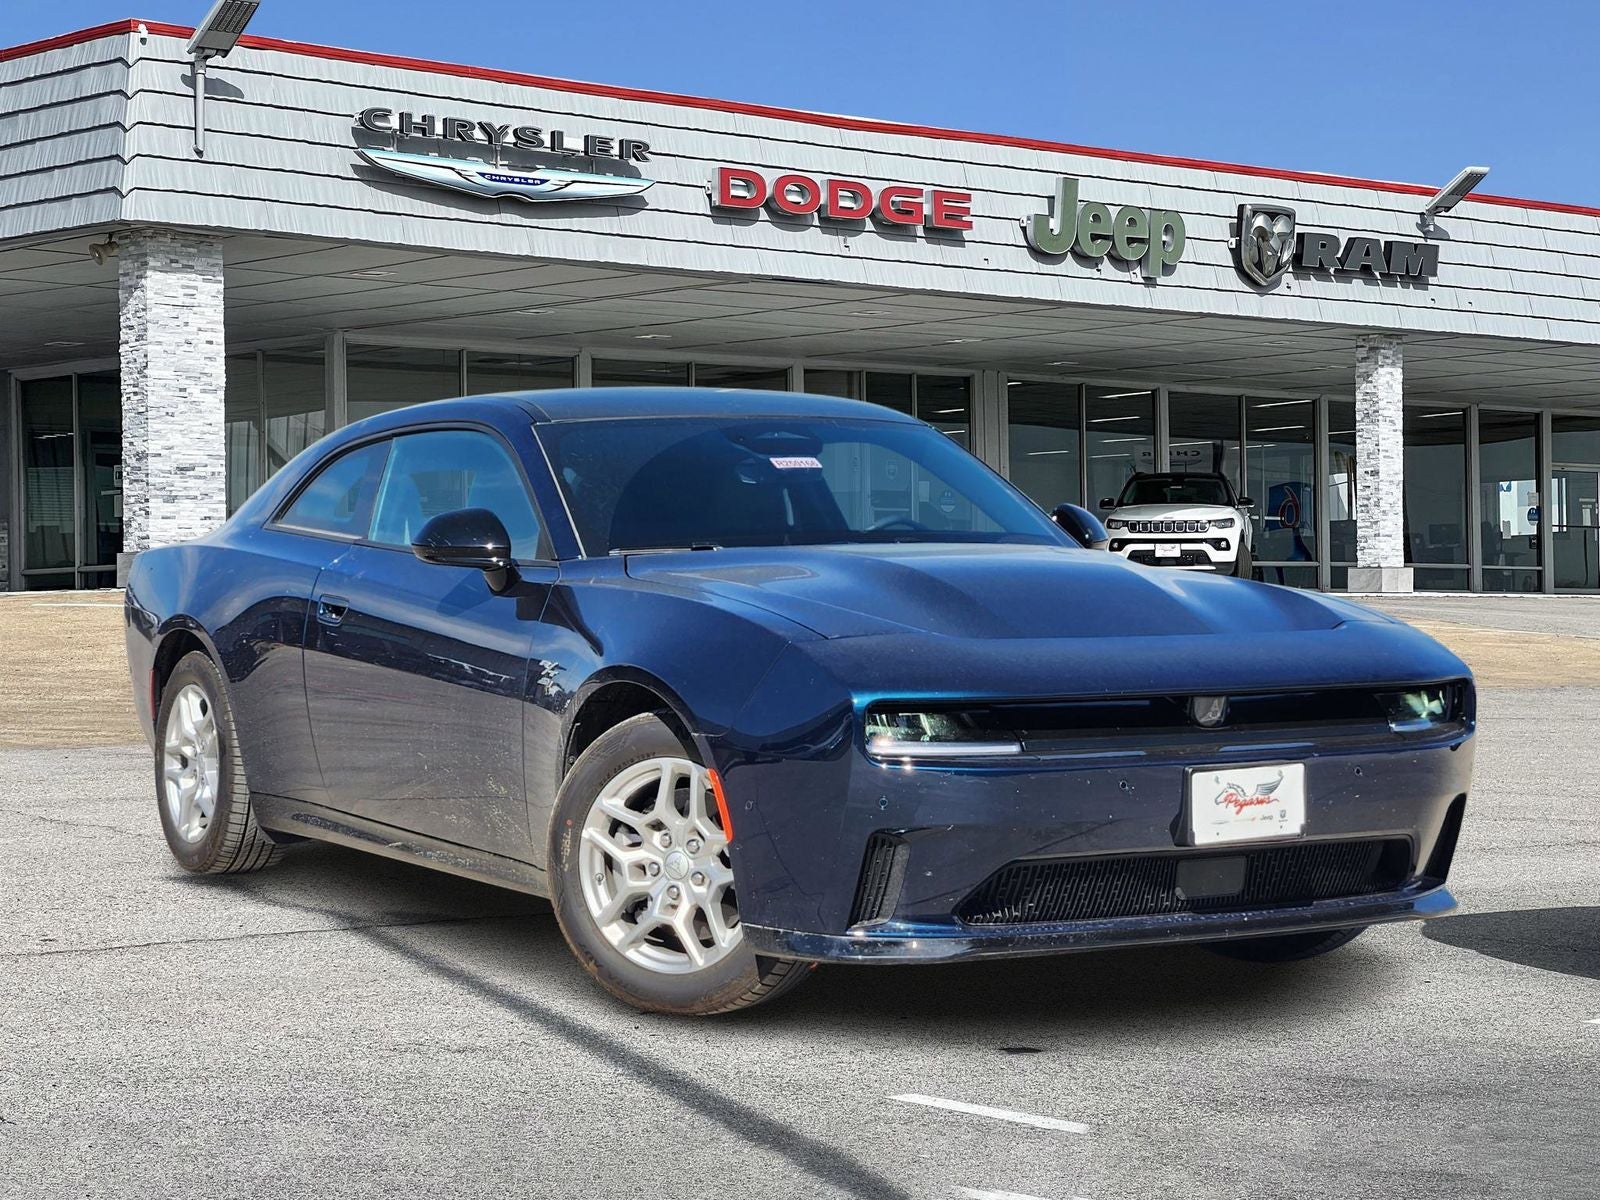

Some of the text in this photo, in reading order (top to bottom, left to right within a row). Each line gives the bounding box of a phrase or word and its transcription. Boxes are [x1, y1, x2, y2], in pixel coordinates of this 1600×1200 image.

[358, 107, 651, 162] CHRYSLER
[484, 174, 541, 185] CHRYSLER
[713, 166, 974, 230] DODGE
[1028, 176, 1187, 278] Jeep
[1299, 231, 1440, 276] RAM
[1222, 792, 1279, 815] Pegasus
